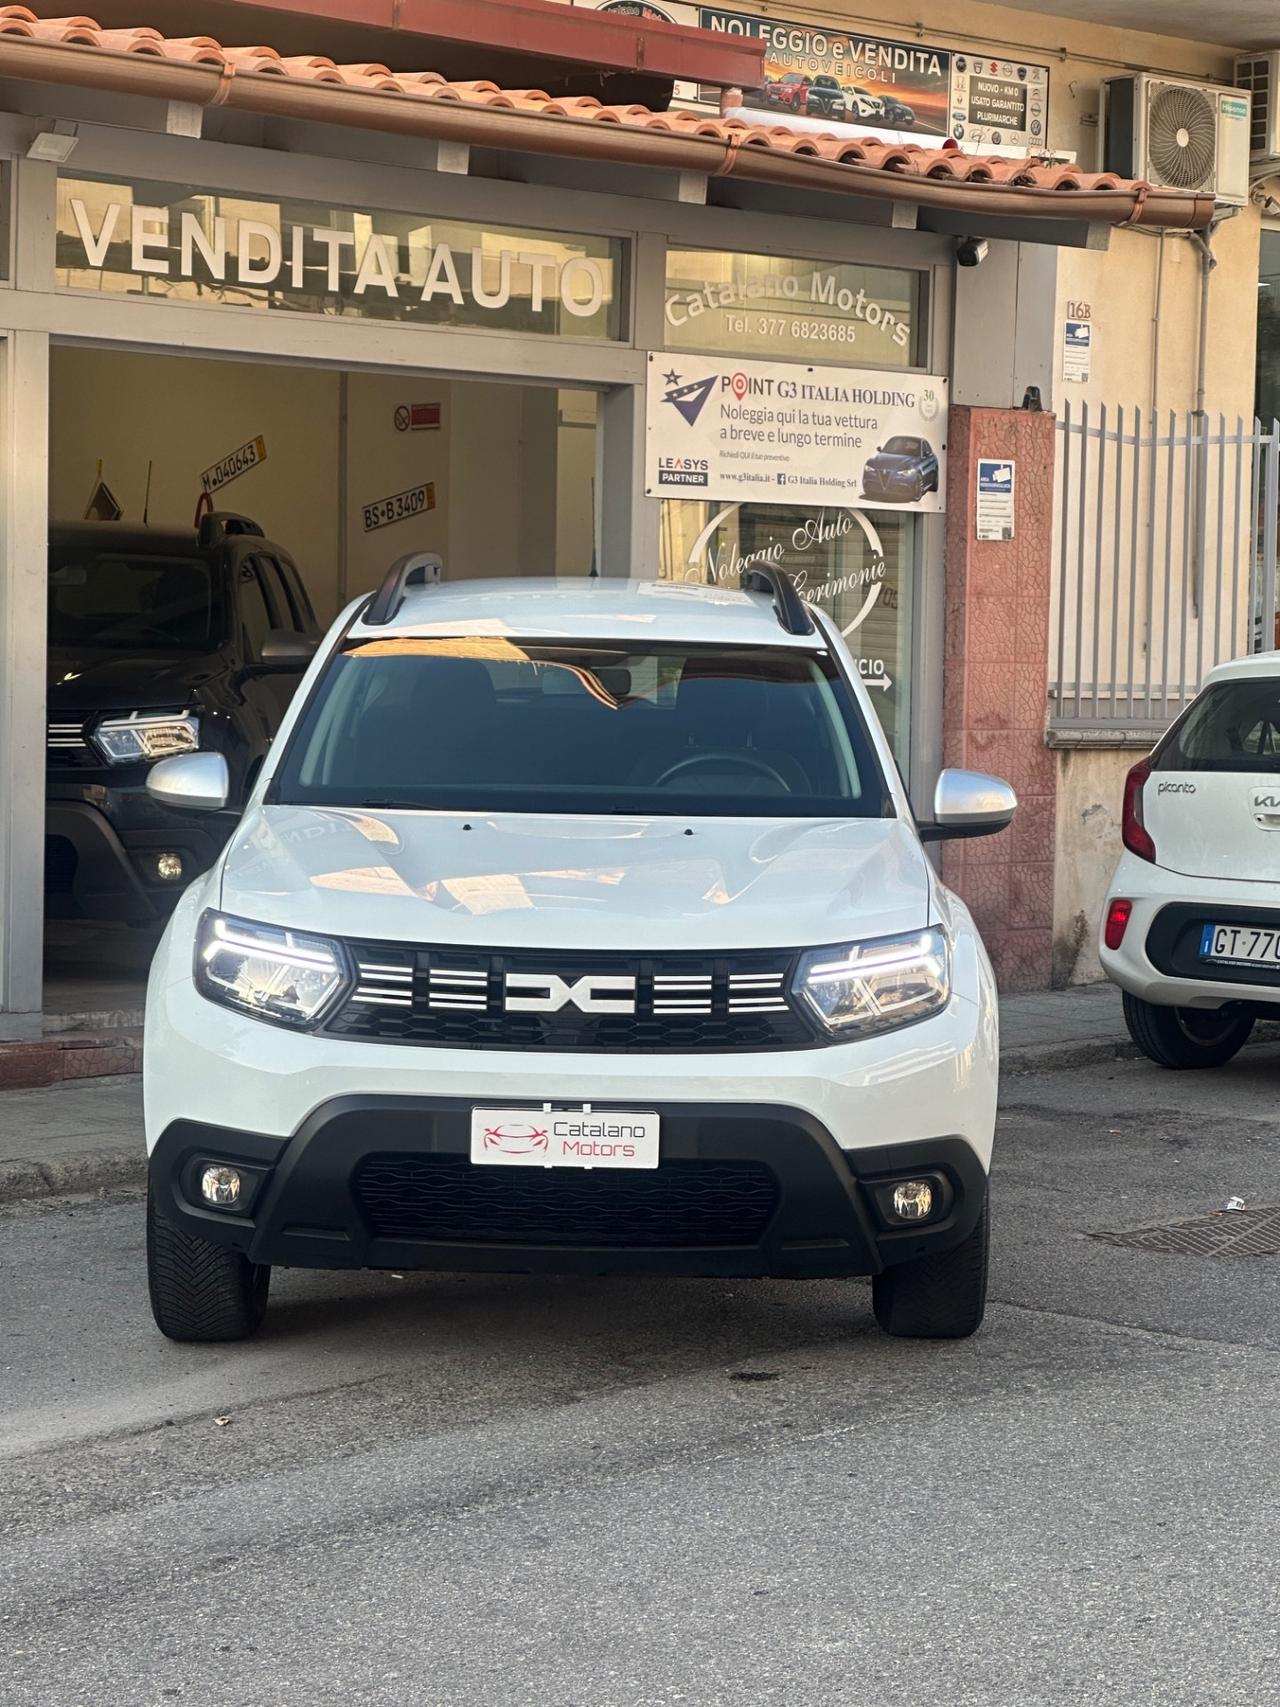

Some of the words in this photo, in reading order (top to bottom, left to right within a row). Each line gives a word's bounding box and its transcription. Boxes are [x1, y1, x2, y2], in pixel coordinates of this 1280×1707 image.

[832, 42, 844, 60] e
[849, 40, 942, 76] VENDITA
[769, 53, 896, 84] AUTOVEICOLI
[977, 82, 999, 93] NUOVO
[1005, 86, 1014, 96] KM
[971, 96, 990, 106] USATO
[992, 99, 1025, 112] GARANTITO
[977, 112, 1018, 125] PLURIMARCHE
[69, 199, 400, 298] VENDITA
[420, 241, 604, 318] AUTO
[665, 272, 799, 327] Catalano
[810, 271, 911, 346] Motors
[1070, 302, 1091, 319] 16B
[726, 315, 752, 334] Tel.
[758, 318, 786, 337] 377
[791, 320, 856, 343] 6823685
[777, 380, 797, 399] G3
[801, 384, 852, 403] ITALIA
[852, 387, 915, 408] HOLDING
[721, 404, 774, 425] Noleggia
[777, 408, 796, 426] qui
[798, 409, 810, 425] la
[812, 412, 832, 426] tua
[834, 414, 878, 430] vettura
[720, 428, 727, 439] a
[730, 425, 765, 442] breve
[767, 431, 775, 442] e
[777, 428, 812, 448] lungo
[815, 432, 862, 448] termine
[658, 457, 709, 471] LEASYS
[662, 473, 706, 484] PARTNER
[800, 476, 817, 485] Italia
[819, 477, 845, 487] Holding
[792, 509, 853, 551] Auto
[1158, 780, 1196, 796] picanto
[1215, 929, 1241, 956] GT
[553, 1122, 646, 1138] Catalano
[563, 1141, 635, 1157] Motors
